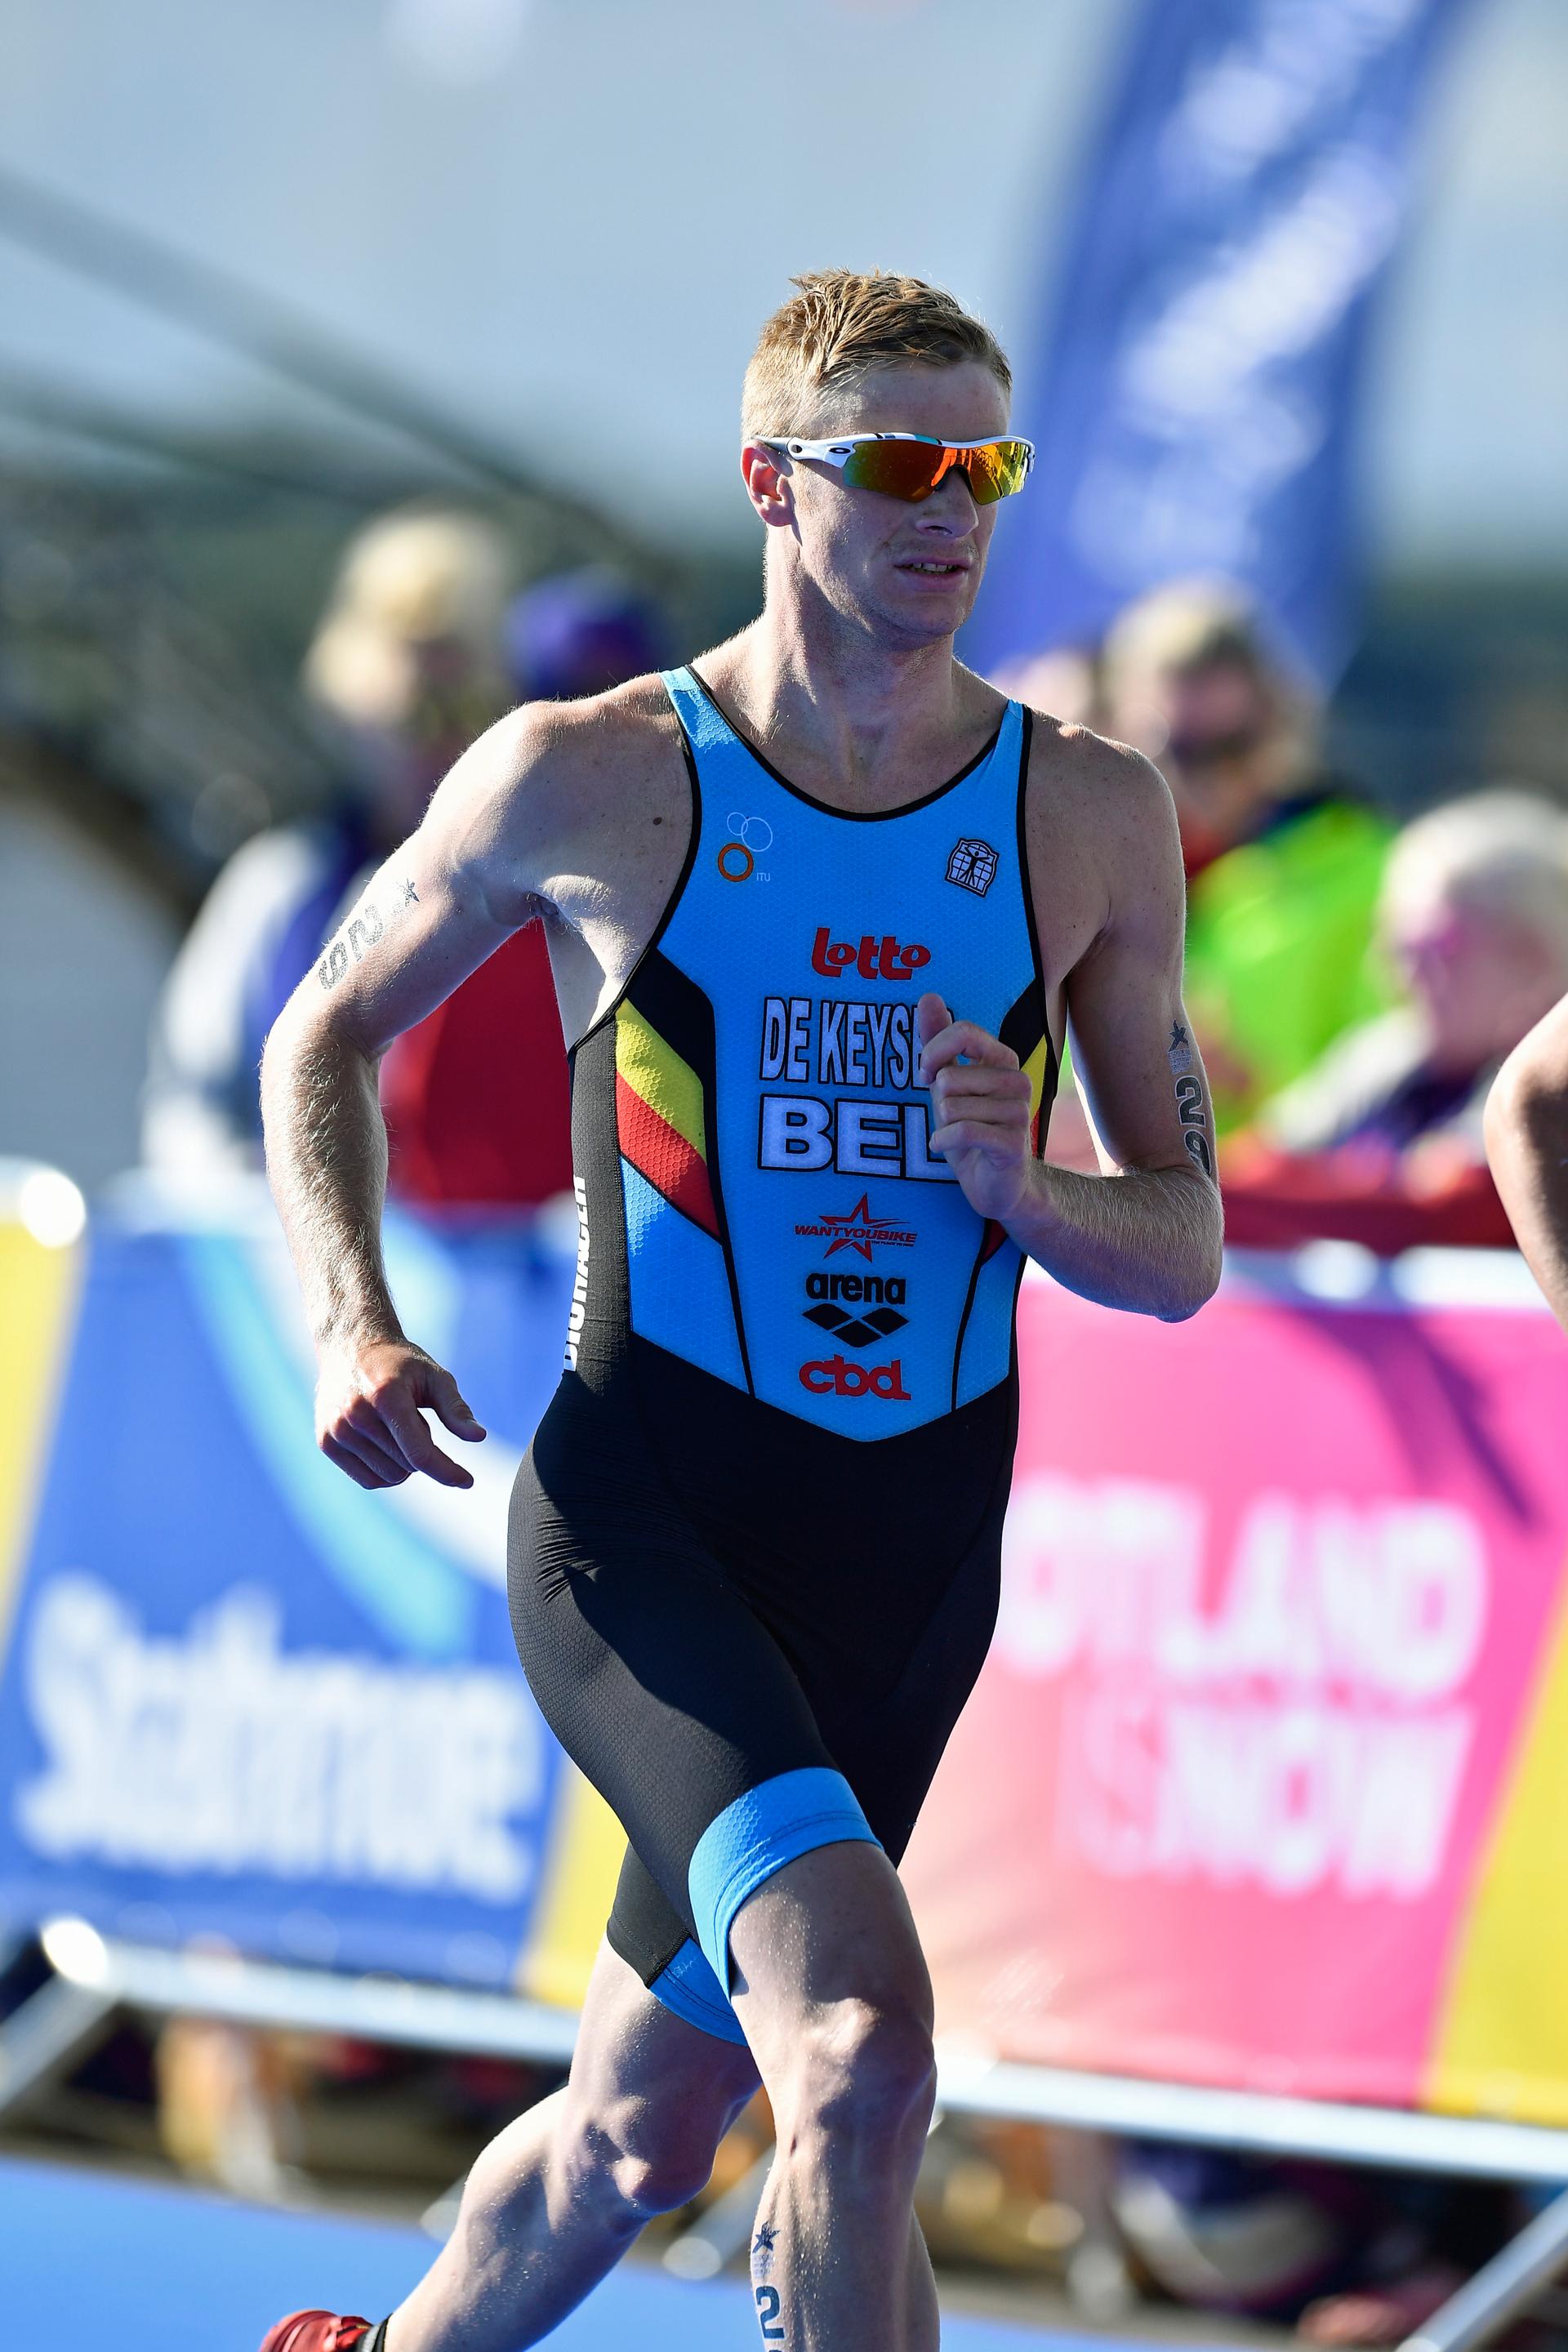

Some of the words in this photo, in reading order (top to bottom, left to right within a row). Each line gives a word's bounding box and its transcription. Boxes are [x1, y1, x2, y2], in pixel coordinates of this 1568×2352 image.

[756, 871, 771, 882] ITU
[760, 996, 812, 1083] DE
[757, 1093, 960, 1184] BEL
[795, 1224, 918, 1243] WANTYOUBIKE
[805, 1272, 906, 1306] arena
[798, 1354, 912, 1401] cbd
[995, 1477, 1490, 1700] OTLAND
[755, 2284, 786, 2352] 2
